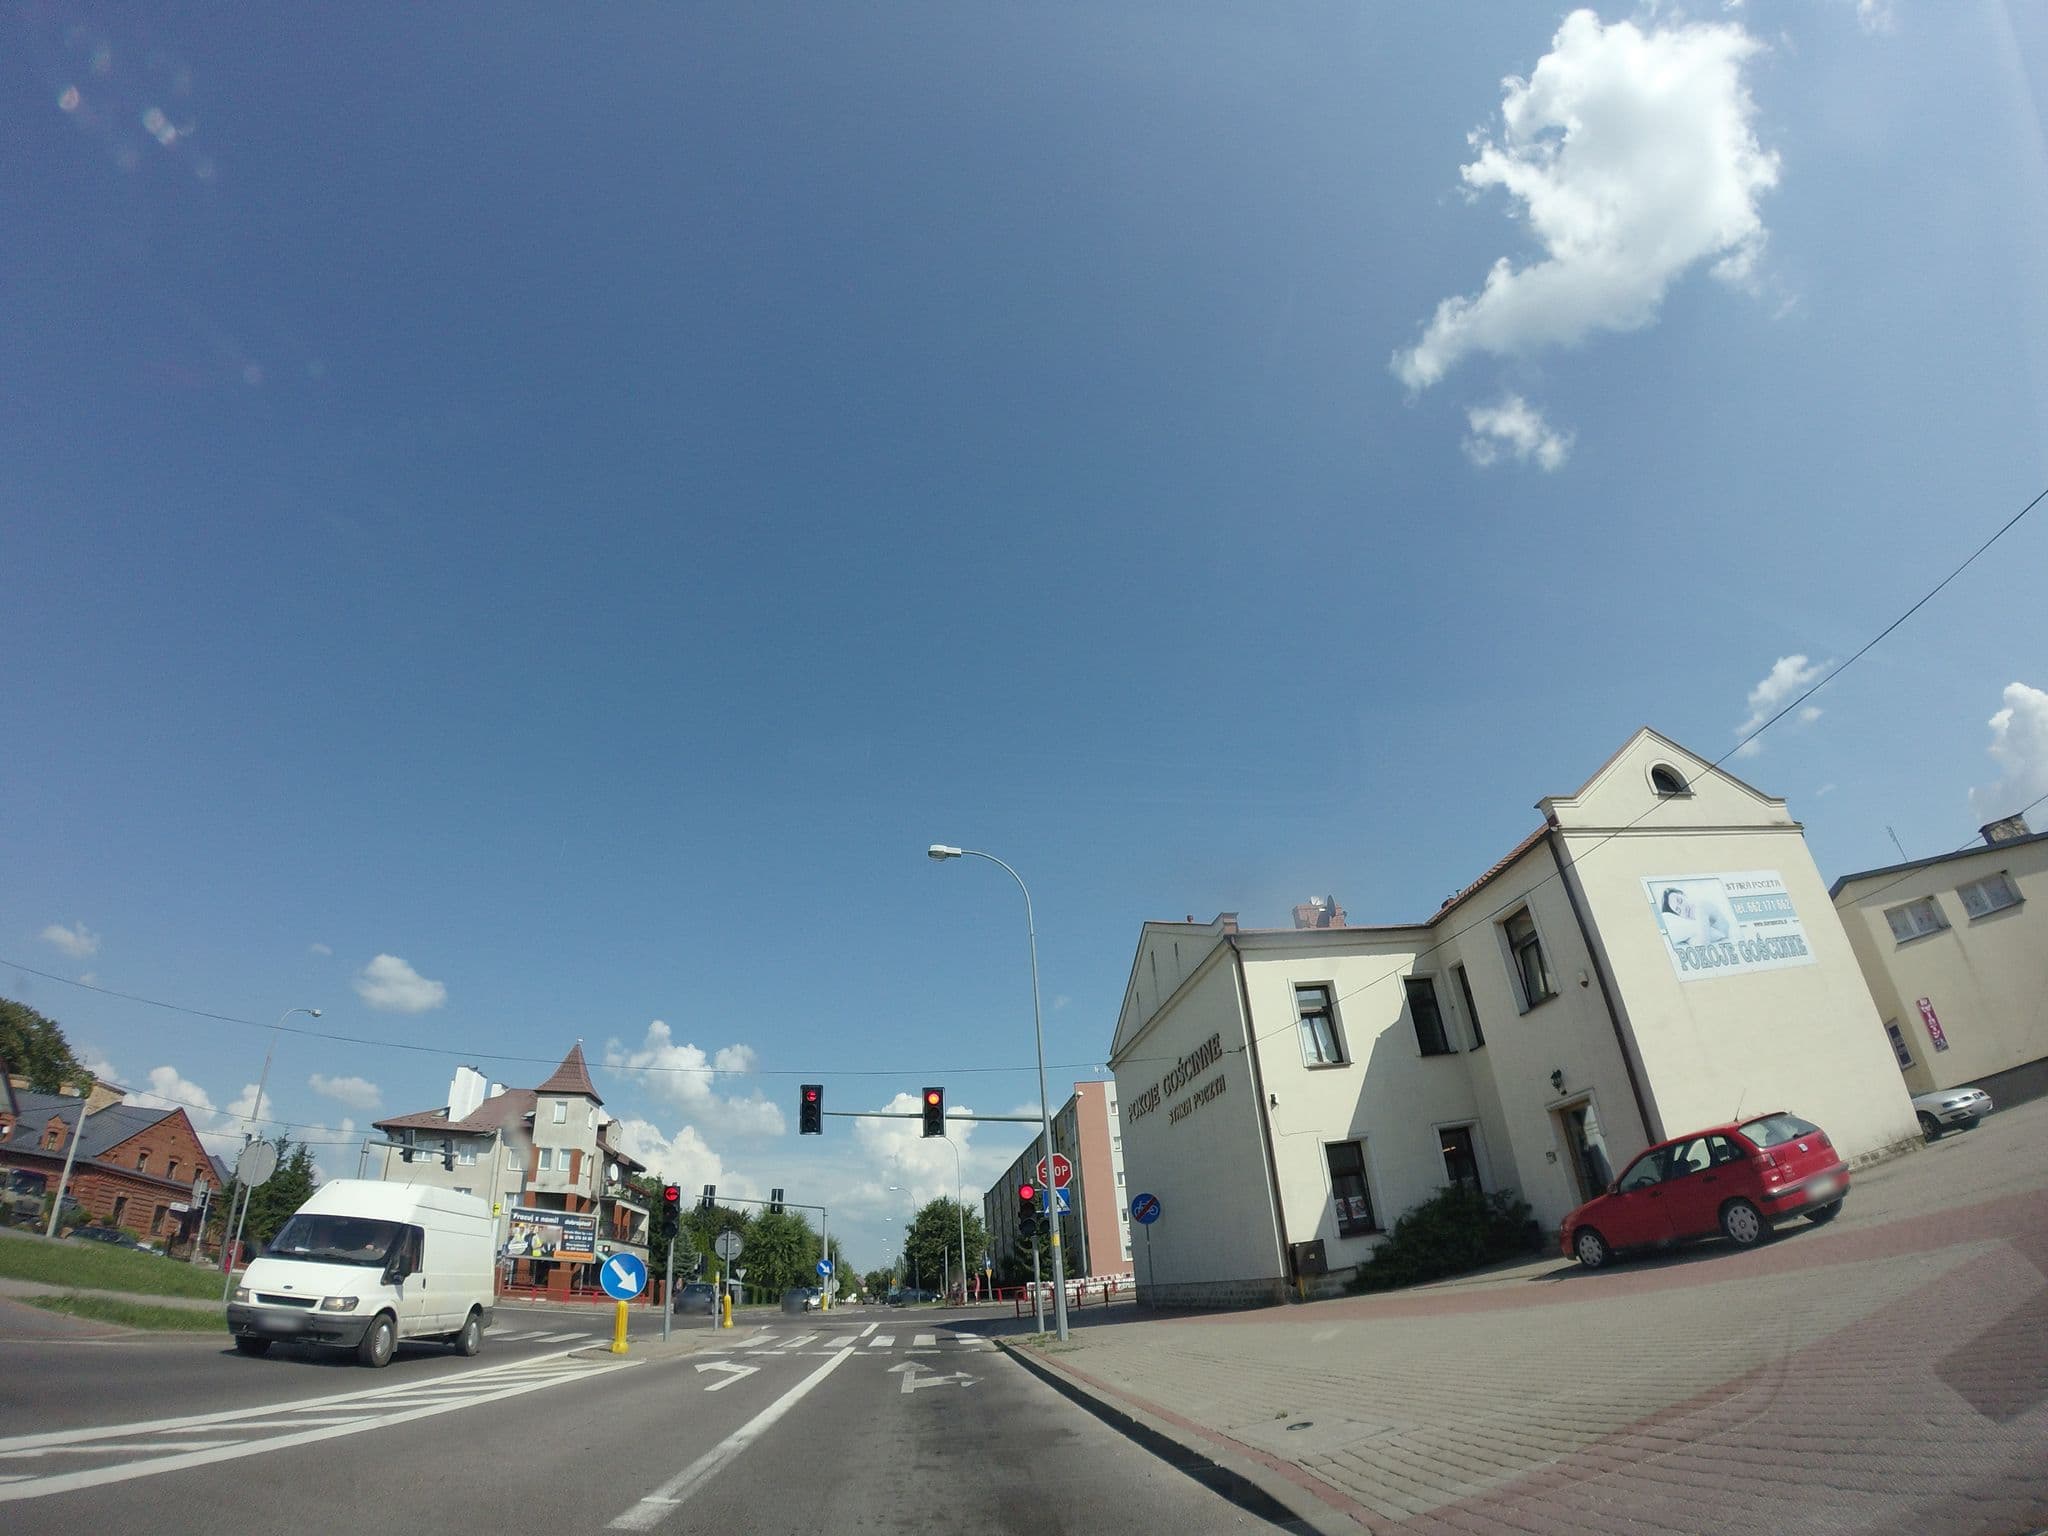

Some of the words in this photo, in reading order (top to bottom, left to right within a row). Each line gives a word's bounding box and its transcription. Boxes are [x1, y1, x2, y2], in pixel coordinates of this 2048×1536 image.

[1676, 942, 1739, 971] POKOJE
[1739, 932, 1808, 963] GOŚCINNE
[1128, 1083, 1161, 1124] POKOJE
[1163, 1033, 1223, 1097] GOŚCINNE
[1169, 1097, 1193, 1125] STARA
[1193, 1074, 1226, 1109] POCZTA
[1041, 1165, 1068, 1178] SOP
